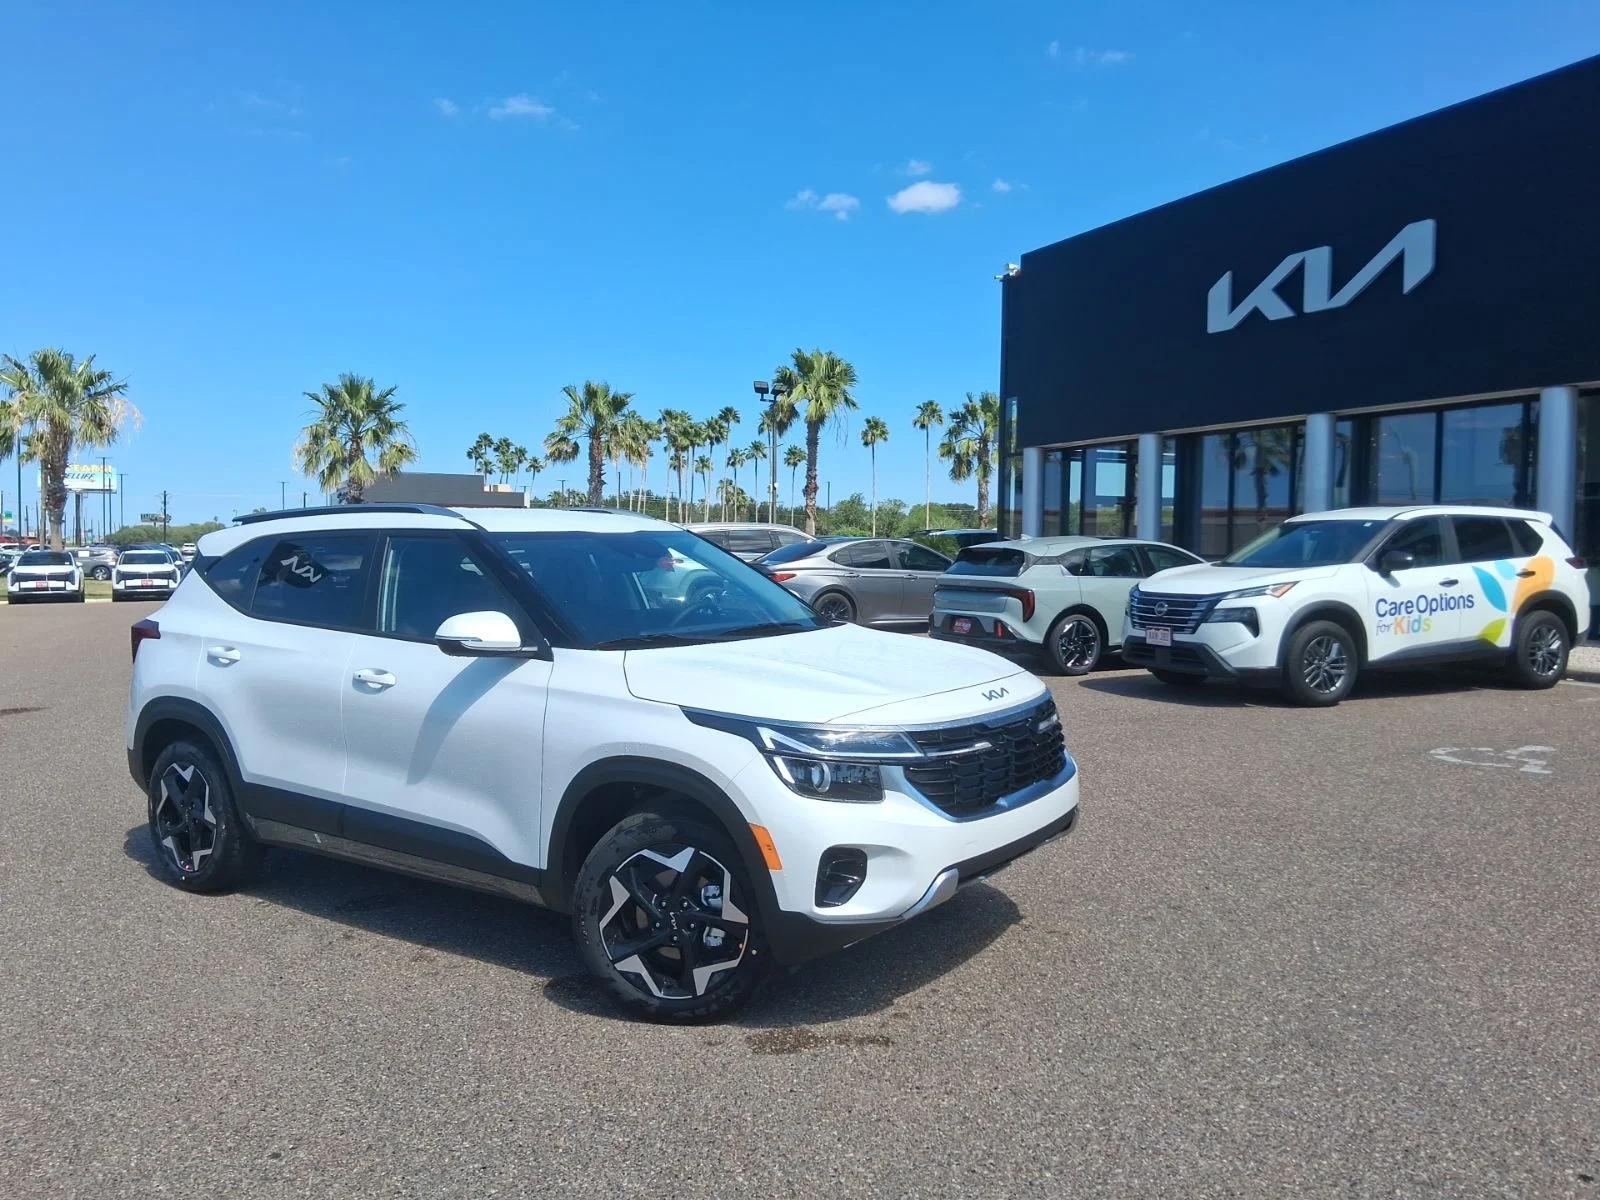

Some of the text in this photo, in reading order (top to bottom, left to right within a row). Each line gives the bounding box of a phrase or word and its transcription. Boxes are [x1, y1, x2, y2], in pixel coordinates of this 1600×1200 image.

[1207, 218, 1436, 334] KIA
[1376, 615, 1432, 636] for Kids
[981, 687, 1009, 701] KIA
